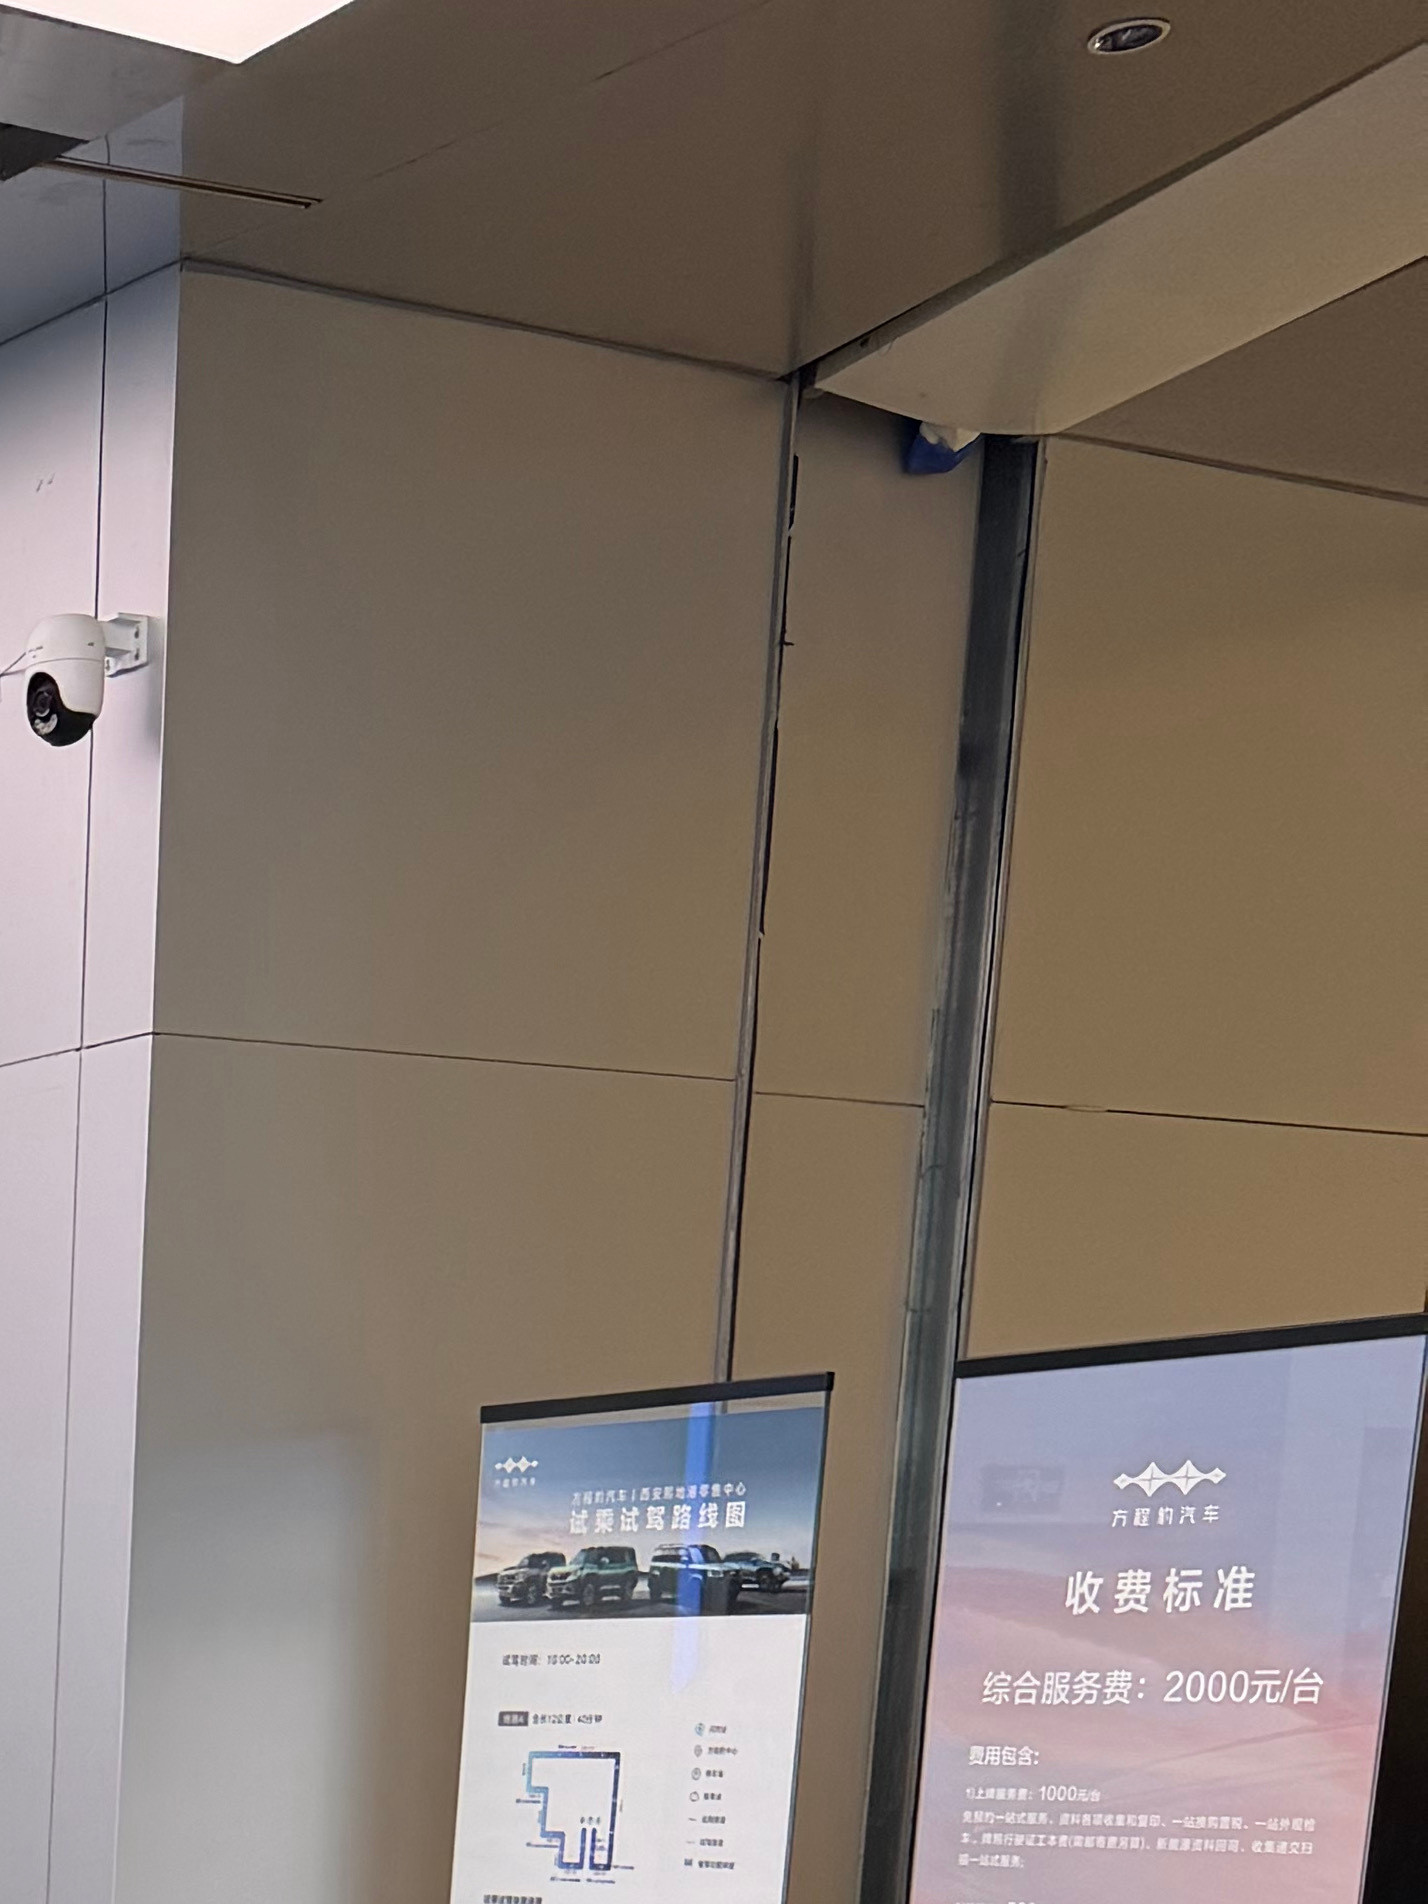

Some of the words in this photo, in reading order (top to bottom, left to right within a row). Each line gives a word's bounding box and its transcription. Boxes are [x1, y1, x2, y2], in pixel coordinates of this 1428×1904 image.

[569, 1500, 746, 1536] 试乘试驾路线图
[1111, 1504, 1221, 1528] 方程豹汽车
[1064, 1565, 1256, 1615] 收费标准
